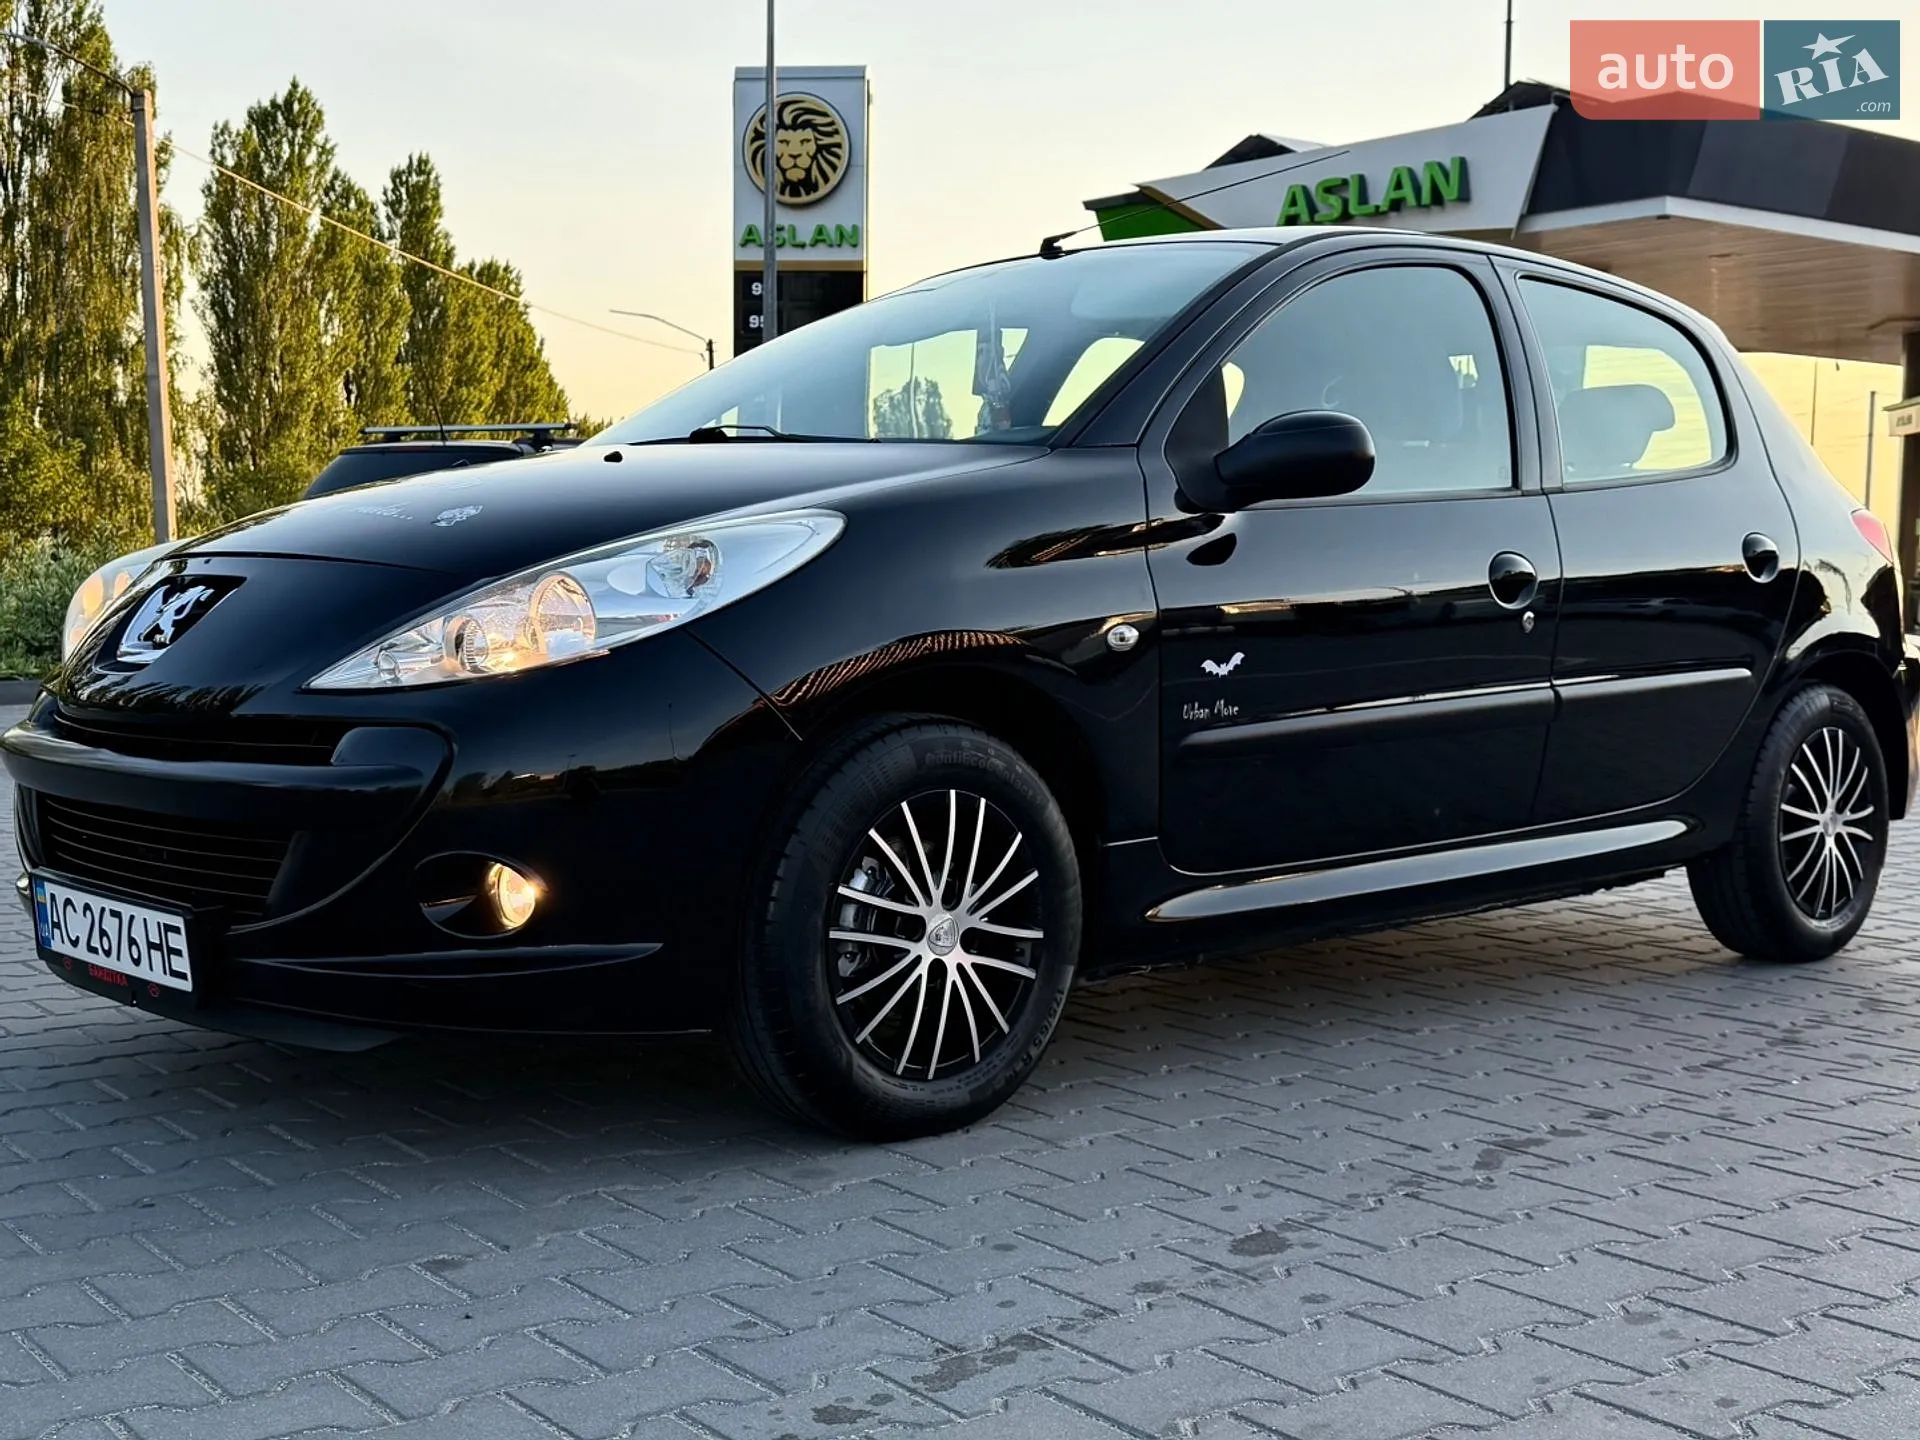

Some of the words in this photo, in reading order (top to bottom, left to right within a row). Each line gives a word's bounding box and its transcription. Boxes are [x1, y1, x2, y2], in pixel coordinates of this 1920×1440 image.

[1276, 156, 1472, 227] ASLAN
[739, 223, 860, 248] ASLAN
[83, 902, 142, 968] 2676
